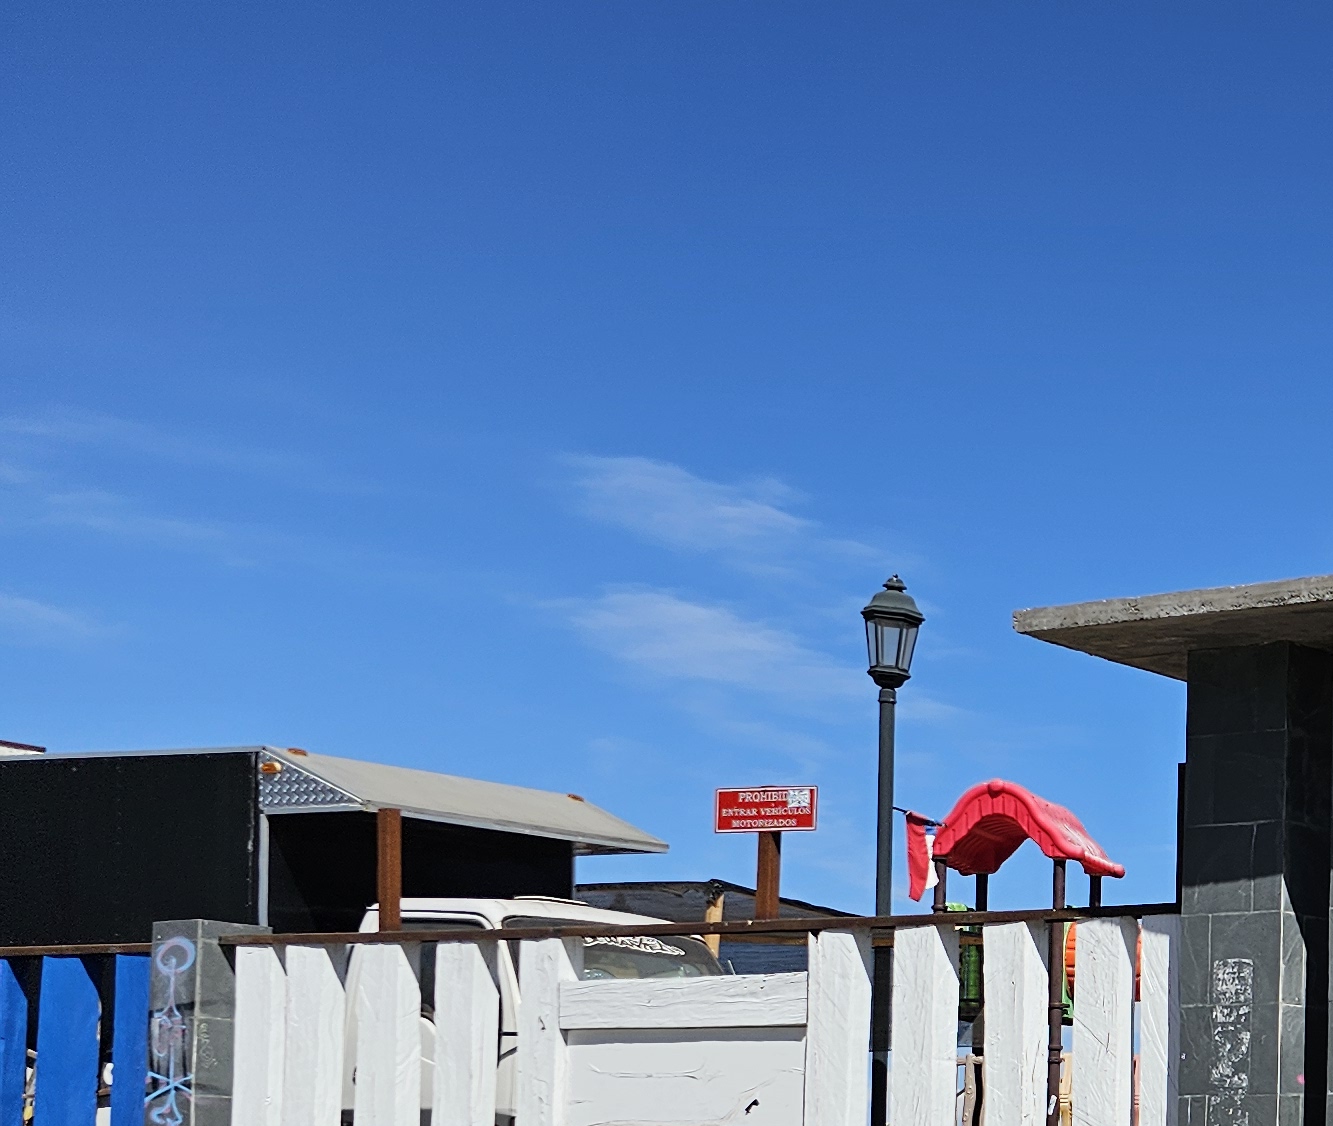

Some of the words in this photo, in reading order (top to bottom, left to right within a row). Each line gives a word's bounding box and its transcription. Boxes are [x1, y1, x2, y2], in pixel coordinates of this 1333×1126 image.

[738, 791, 788, 802] PROHIBID
[722, 808, 758, 816] ENTRAR
[731, 819, 797, 827] MOTORIZADOS
